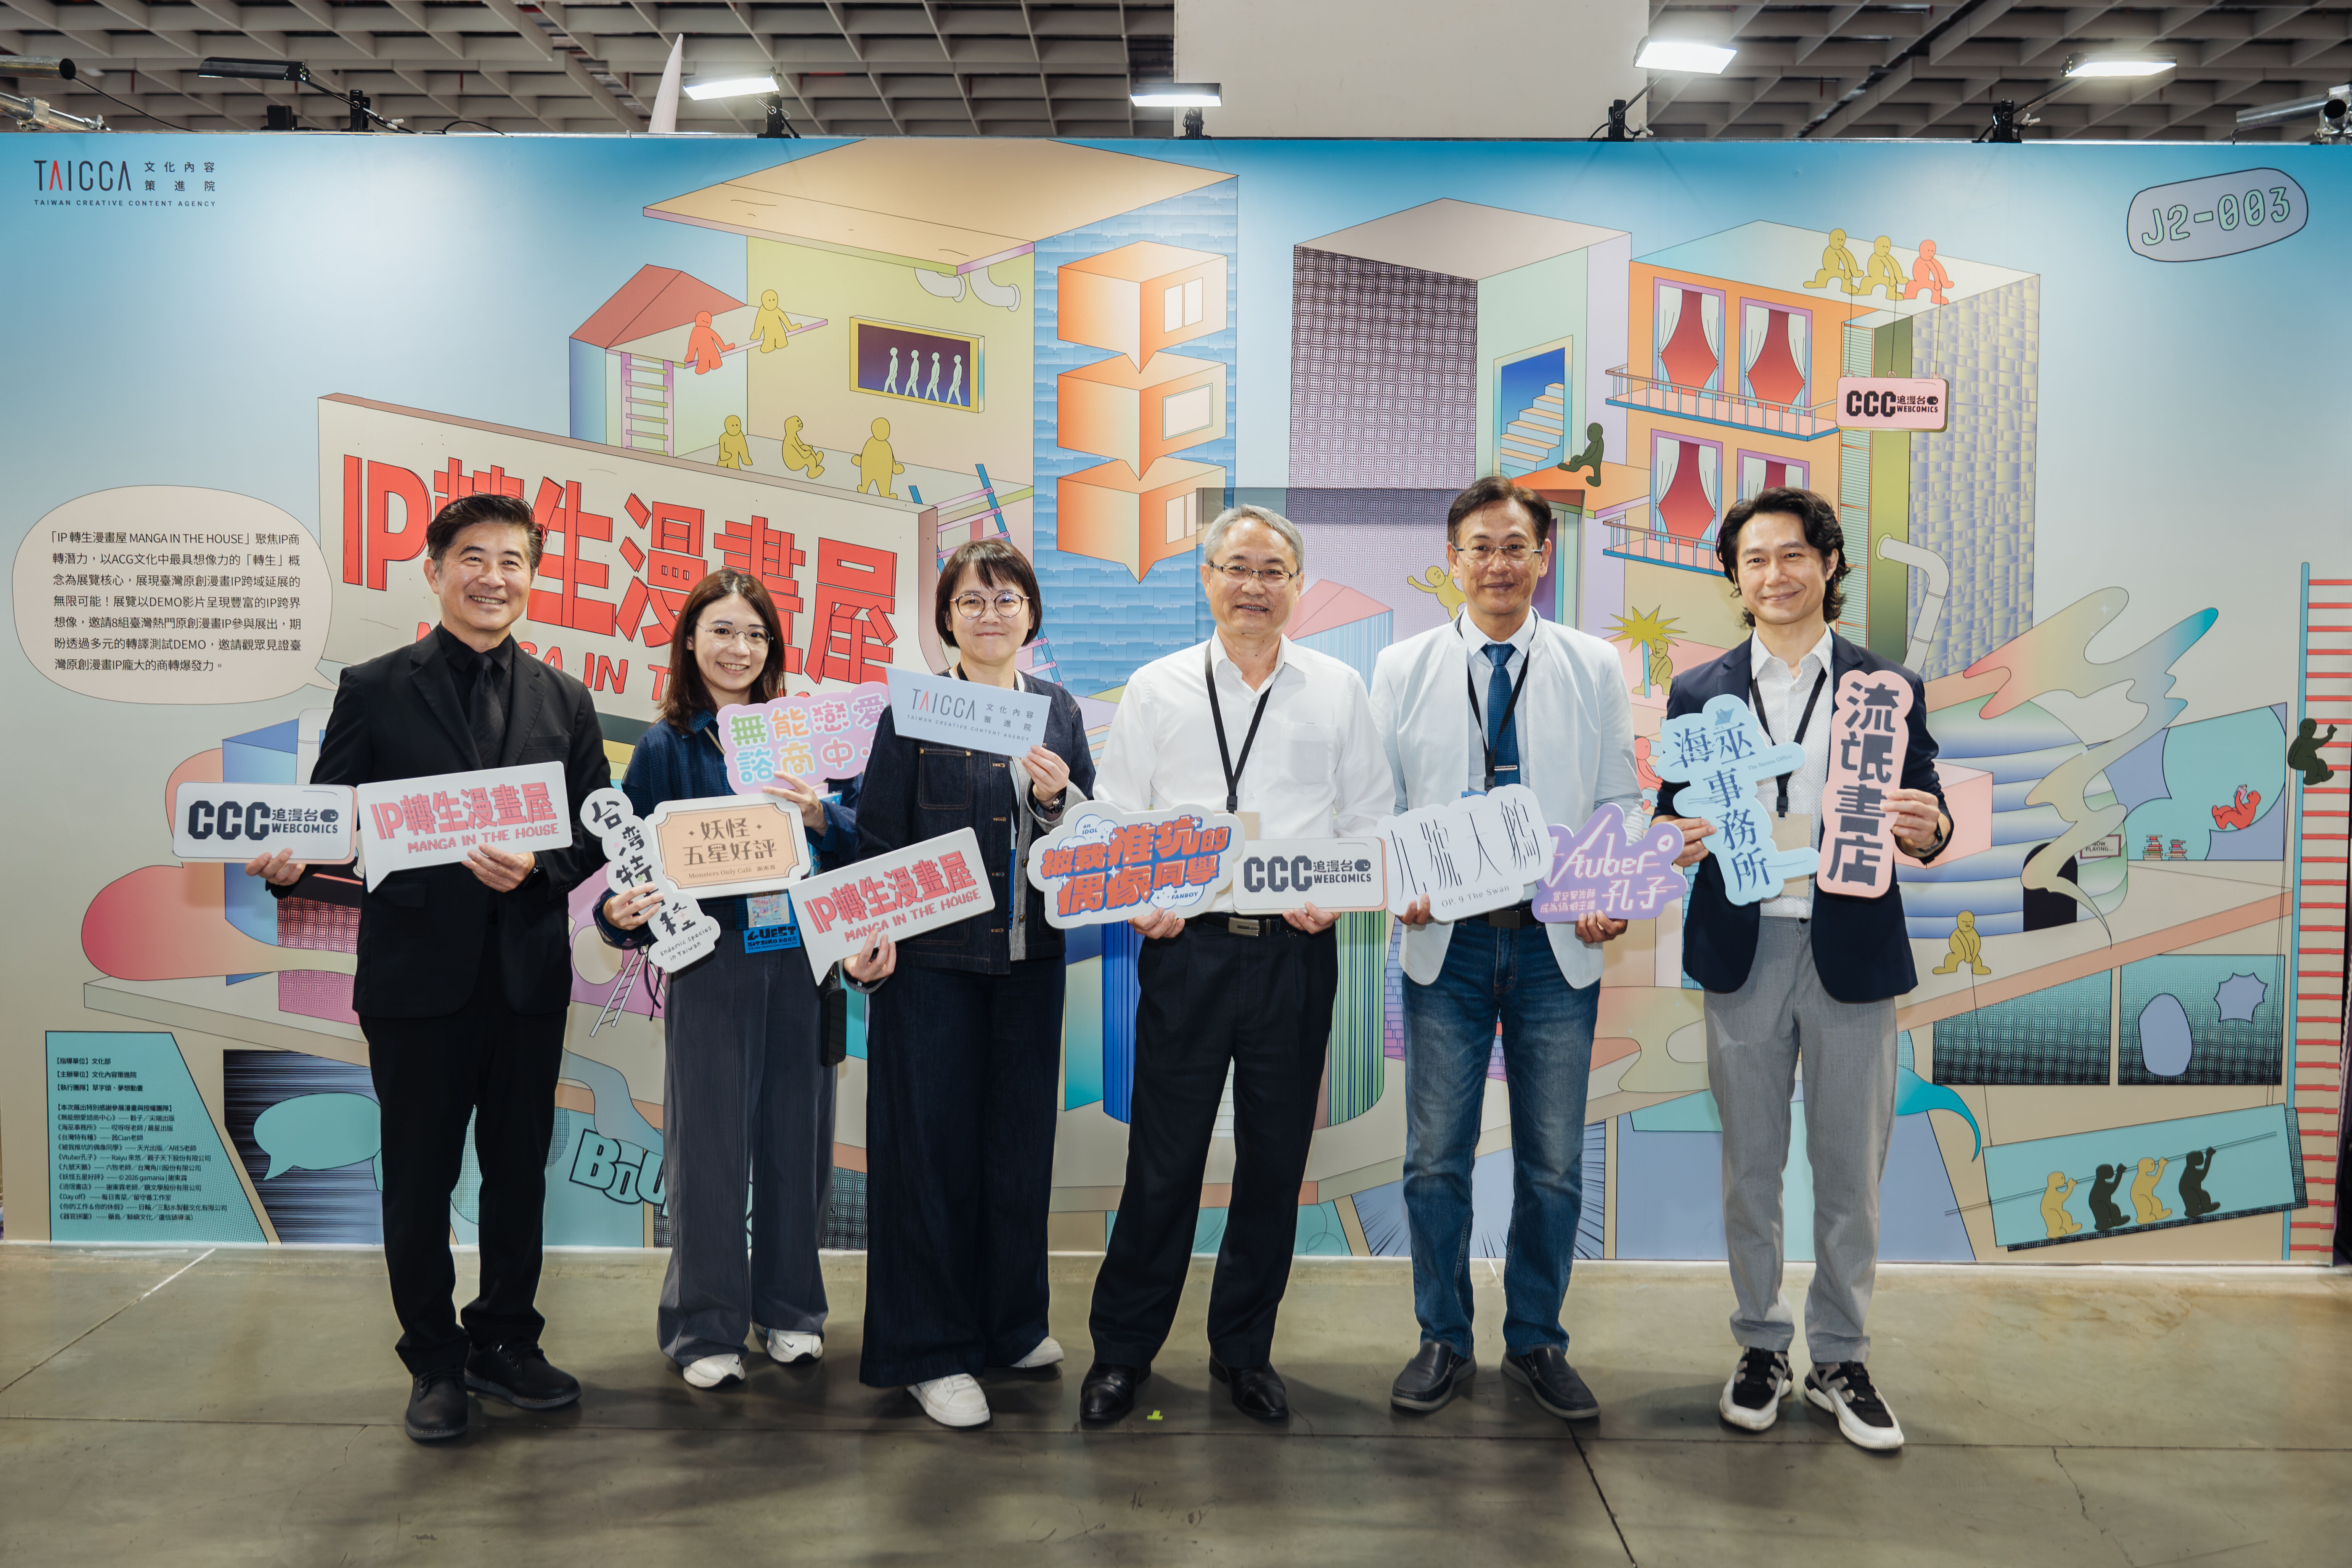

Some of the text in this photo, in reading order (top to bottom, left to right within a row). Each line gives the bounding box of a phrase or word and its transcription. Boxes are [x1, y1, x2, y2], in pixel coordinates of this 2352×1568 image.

[34, 160, 131, 191] TAICCA
[145, 161, 214, 172] 文化內容
[145, 180, 215, 191] 策進院
[2142, 187, 2290, 245] J2-003
[1846, 390, 1896, 417] CCC
[1897, 395, 1925, 405] 追漫台
[130, 533, 168, 543] MANGA
[170, 533, 180, 543] IN
[183, 534, 204, 543] THE
[344, 455, 897, 685] IP生漫畫屋
[583, 652, 628, 694] IN
[912, 688, 975, 721] TAICCA
[986, 703, 1034, 719] 文化內容
[731, 692, 885, 747] 無能戀愛
[907, 714, 1029, 741] TAIWAN CREATIVE CONTENT AGENCY
[983, 715, 1031, 731] 策進院
[736, 738, 874, 783] 諮商中
[1827, 681, 1899, 886] 流氓書店
[188, 800, 271, 840] CCC
[272, 808, 318, 822] 追漫台
[370, 782, 557, 840] IP轉生漫畫屋
[272, 823, 338, 834] WEBCOMICS
[408, 823, 559, 854] MANGA IN THE HOUSE
[700, 818, 750, 841] 妖怪
[683, 839, 777, 866] 五星好評
[1041, 815, 1231, 879] 被我推坑的
[1386, 798, 1540, 901] 九號天鵝
[1243, 855, 1312, 892] CCC
[1314, 860, 1353, 872] 追漫台
[1314, 874, 1371, 883] WEBCOMICS
[804, 850, 977, 934] IP轉生漫畫屋
[1057, 853, 1220, 917] 偶像同學
[1171, 891, 1199, 900] FANBOY
[1441, 898, 1456, 907] OP.
[1467, 892, 1483, 900] The
[1486, 885, 1509, 896] Swan
[1602, 876, 1678, 912] 孔子
[844, 888, 982, 943] MANGA IN THE HOUSE
[660, 940, 686, 956] Endemic
[677, 941, 701, 956] Taiwan
